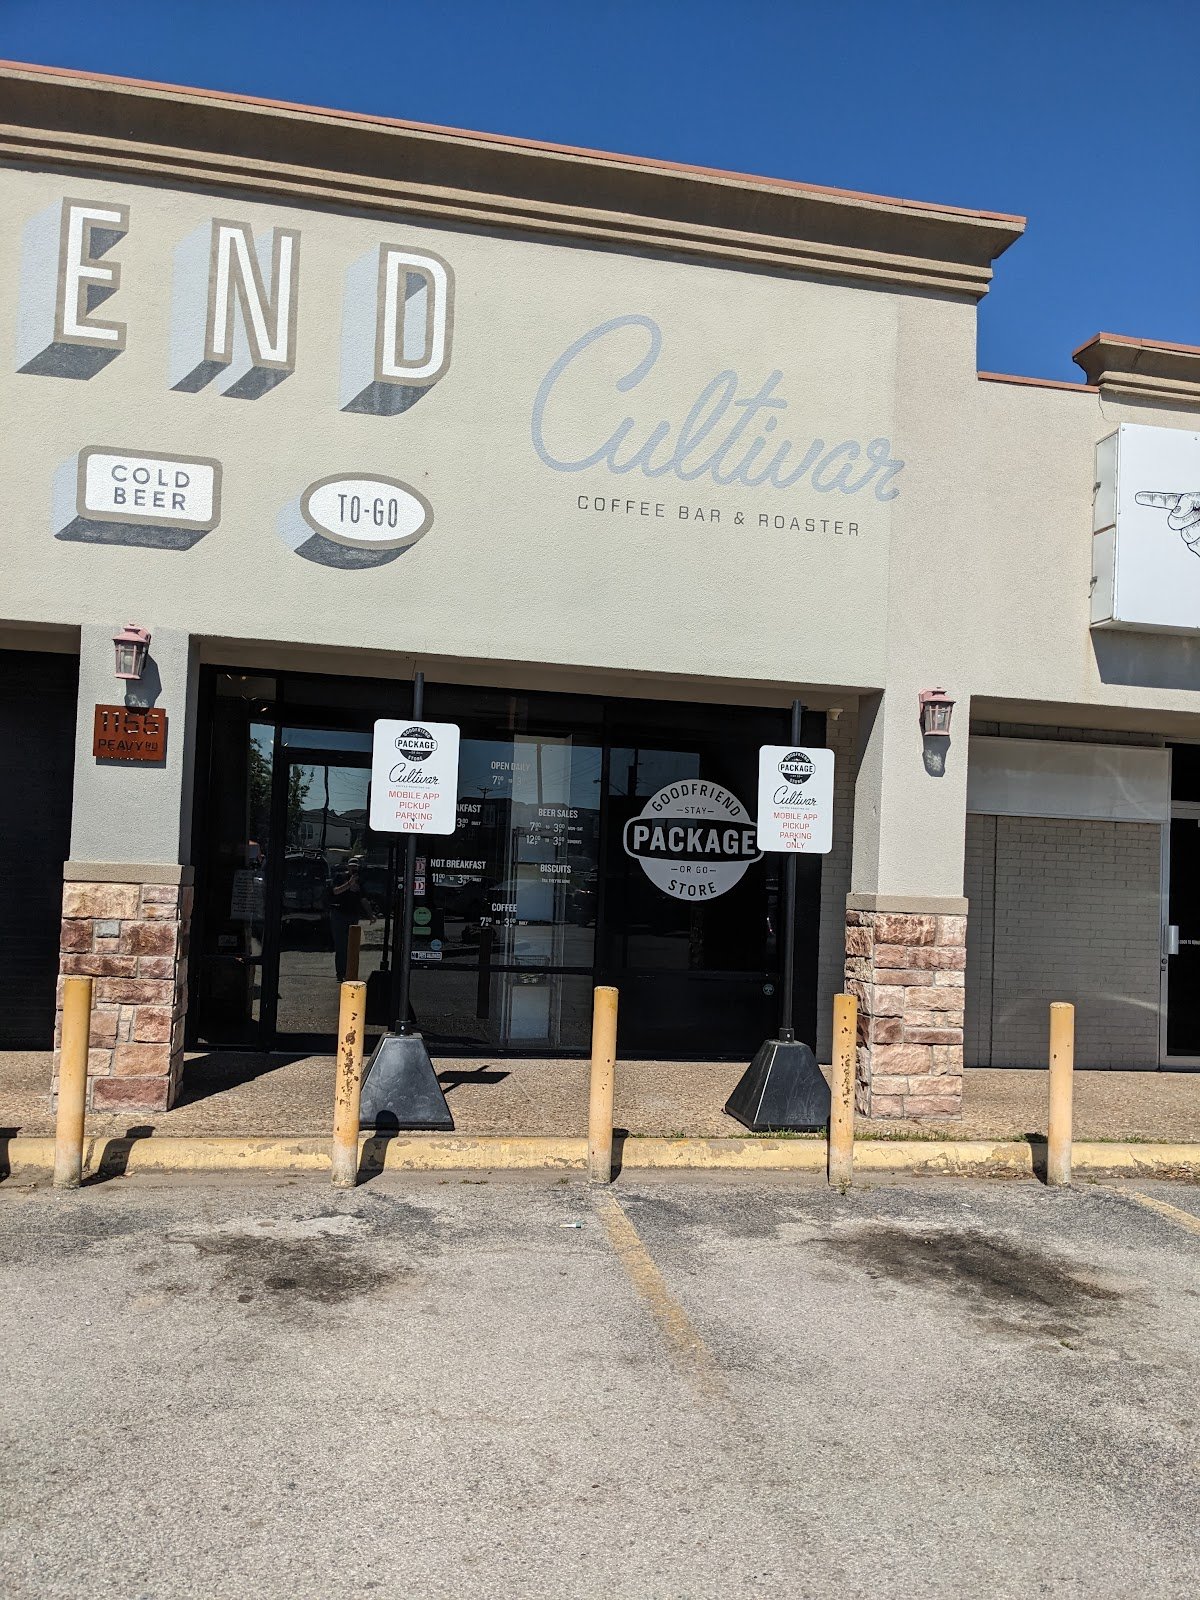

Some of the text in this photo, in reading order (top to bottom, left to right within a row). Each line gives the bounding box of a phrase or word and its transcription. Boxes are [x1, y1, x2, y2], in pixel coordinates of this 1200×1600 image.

[53, 196, 456, 387] END
[531, 314, 905, 502] Cultivar
[111, 464, 191, 489] COLD
[113, 486, 187, 511] BEER
[338, 493, 398, 528] TO-GO
[577, 495, 860, 537] COFFEE BAR & ROASTER
[101, 711, 159, 735] 1155
[98, 738, 143, 752] PEAVY
[397, 739, 436, 750] PACKAGE
[491, 761, 510, 770] OPEN
[780, 763, 814, 773] PACKAGE
[389, 762, 439, 785] Cultivar
[389, 790, 440, 800] MOBILE APP
[652, 783, 741, 817] GOODFRIEND
[773, 785, 817, 806] Cultivar
[399, 802, 431, 810] PICKUP
[685, 807, 707, 815] STAY
[395, 811, 433, 820] PARKING
[539, 808, 578, 818] BEER SALES
[773, 812, 818, 821] MOBILE APP
[402, 822, 425, 830] ONLY
[633, 825, 756, 855] PACKAGE
[779, 832, 812, 840] PARKING
[430, 858, 445, 868] NOT
[446, 859, 487, 870] BREAKFAST
[540, 864, 571, 873] BISCUITS
[679, 865, 708, 874] OR GO
[668, 879, 717, 896] STORE
[491, 903, 517, 912] COFFEE
